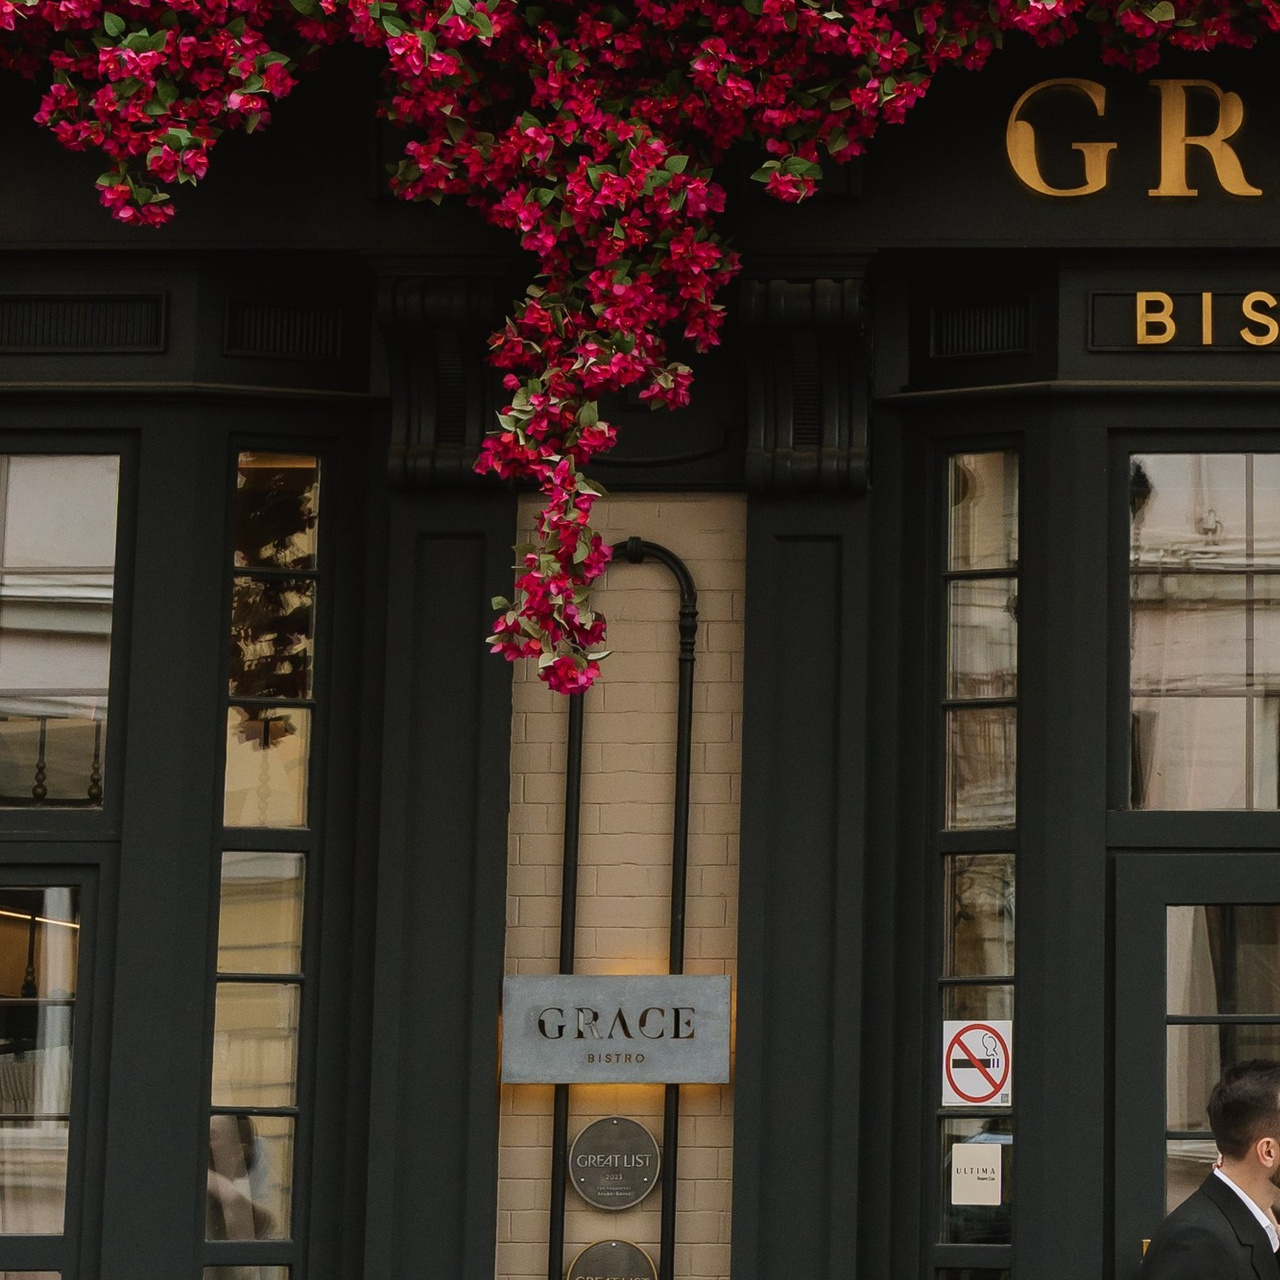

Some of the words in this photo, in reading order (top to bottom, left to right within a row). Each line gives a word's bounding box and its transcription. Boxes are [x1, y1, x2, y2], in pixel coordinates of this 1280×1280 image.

[537, 1006, 695, 1040] GRACE
[587, 1053, 646, 1063] BISTRO
[576, 1154, 621, 1168] GREAT
[624, 1154, 652, 1167] LIST
[956, 1167, 996, 1175] ULTIMA
